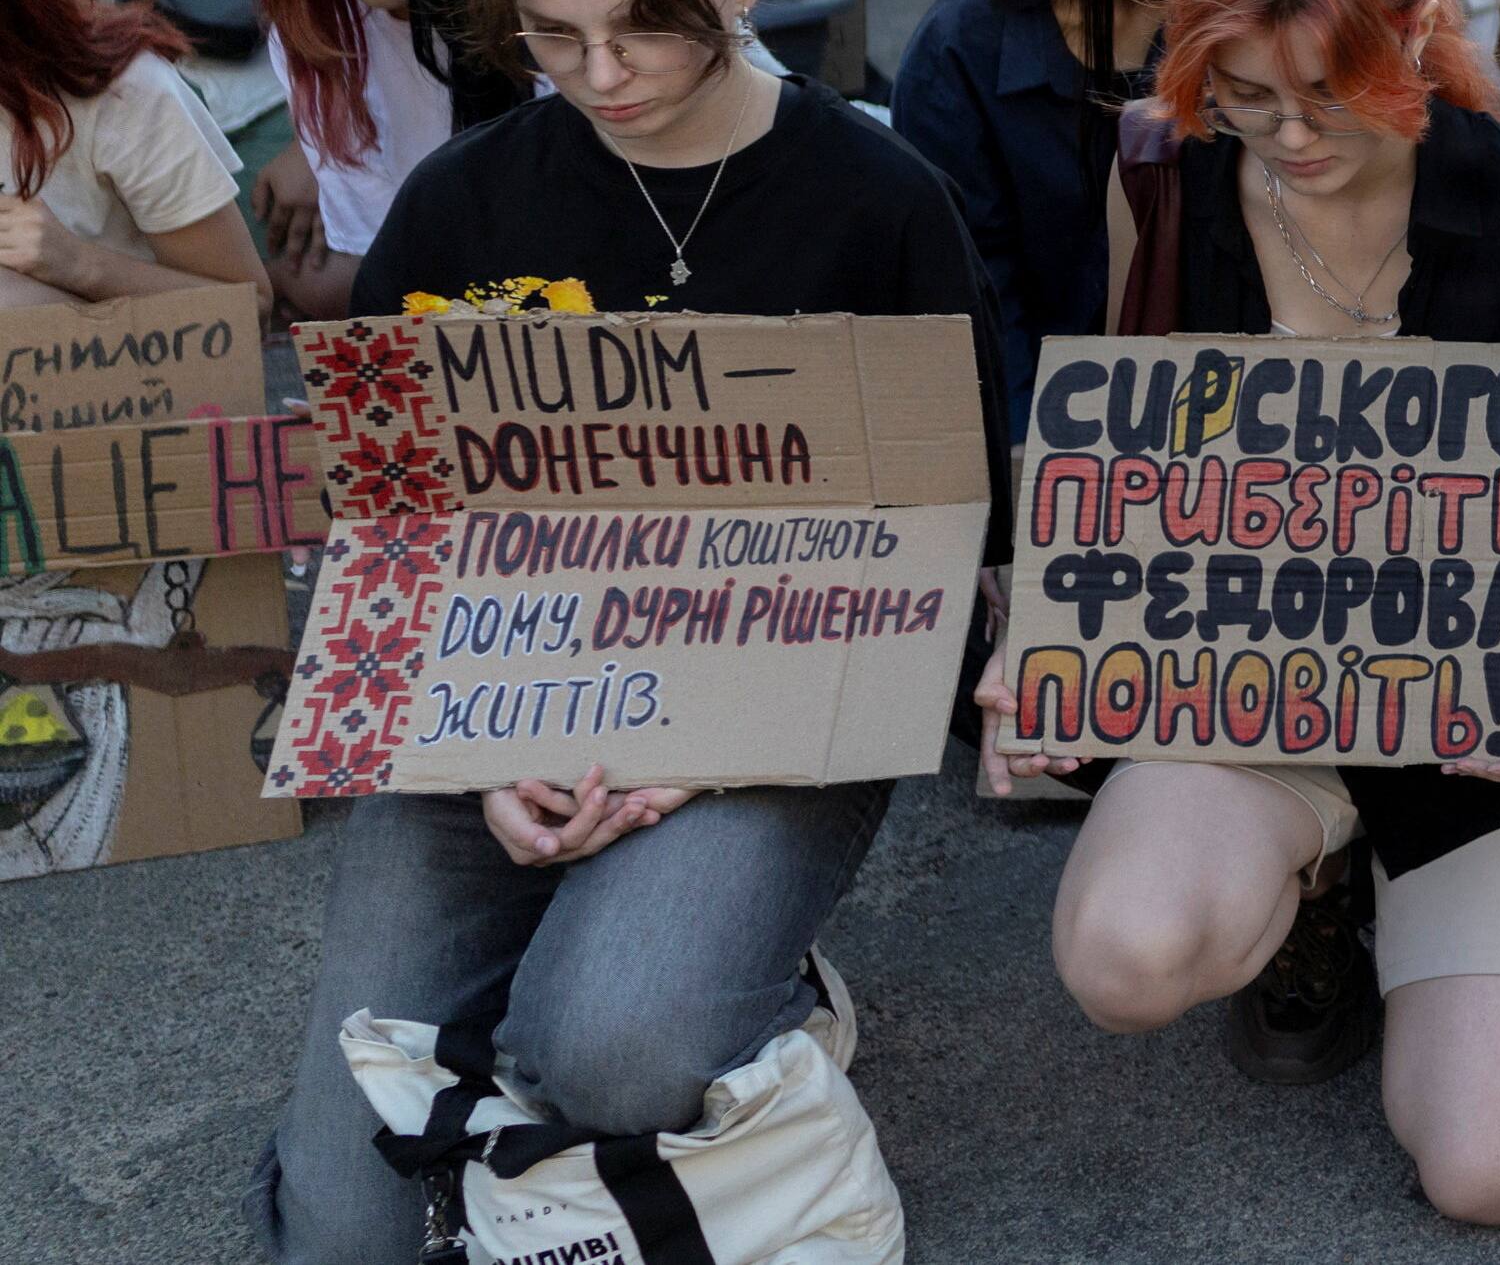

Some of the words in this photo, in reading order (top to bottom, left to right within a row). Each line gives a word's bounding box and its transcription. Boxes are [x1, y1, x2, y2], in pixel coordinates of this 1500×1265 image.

[435, 322, 575, 414] МІЙ
[595, 324, 711, 414] ДІМ
[51, 426, 192, 558] ЦЕ
[208, 416, 328, 557] НЕ
[455, 510, 691, 580] ПОМИЛКИ
[698, 517, 899, 570] КОШТУЮТЬ
[435, 591, 583, 663] ДОМУ,
